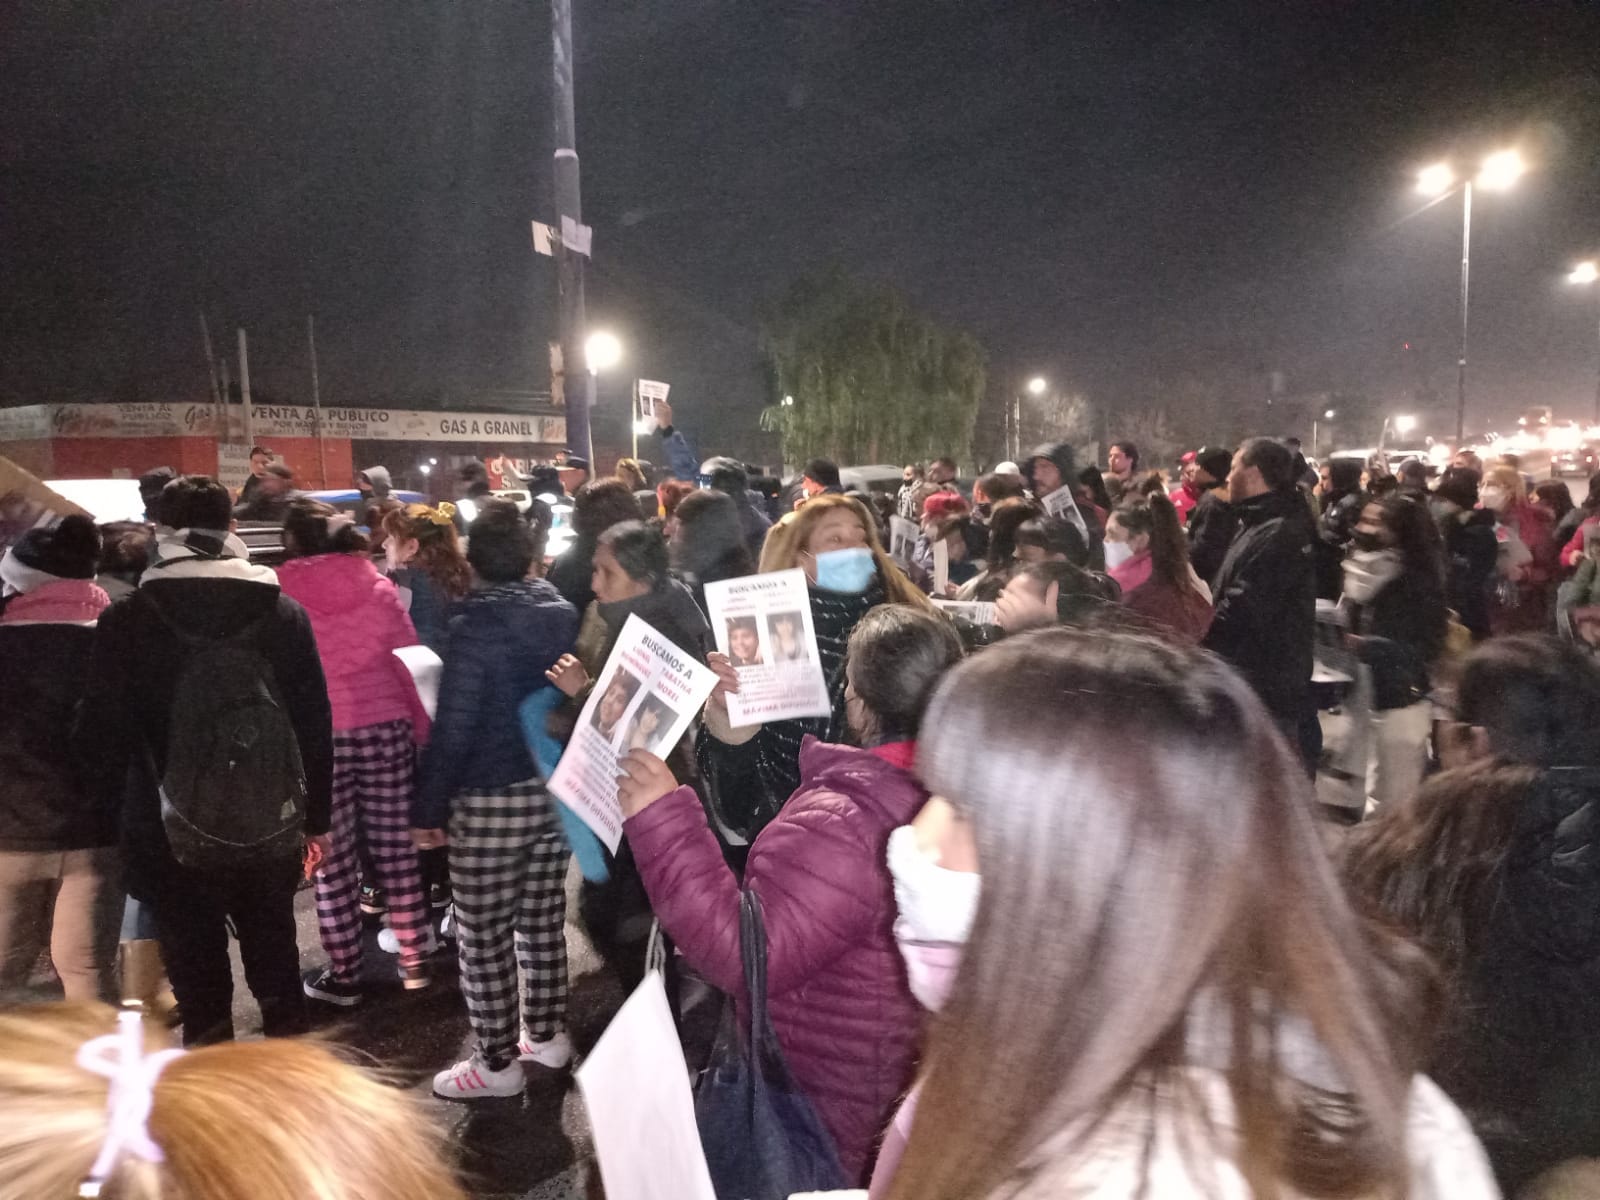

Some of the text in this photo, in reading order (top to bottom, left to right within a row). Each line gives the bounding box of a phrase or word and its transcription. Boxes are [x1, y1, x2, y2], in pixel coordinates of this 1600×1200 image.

[251, 406, 300, 419] VENTA
[328, 409, 390, 422] PUBLICO
[294, 421, 326, 429] MAYR
[440, 419, 467, 434] GAS
[471, 420, 481, 434] A
[484, 420, 533, 436] GRANEL
[641, 634, 685, 673] BUSCAMOS
[683, 669, 693, 680] A
[656, 681, 680, 702] MOREL
